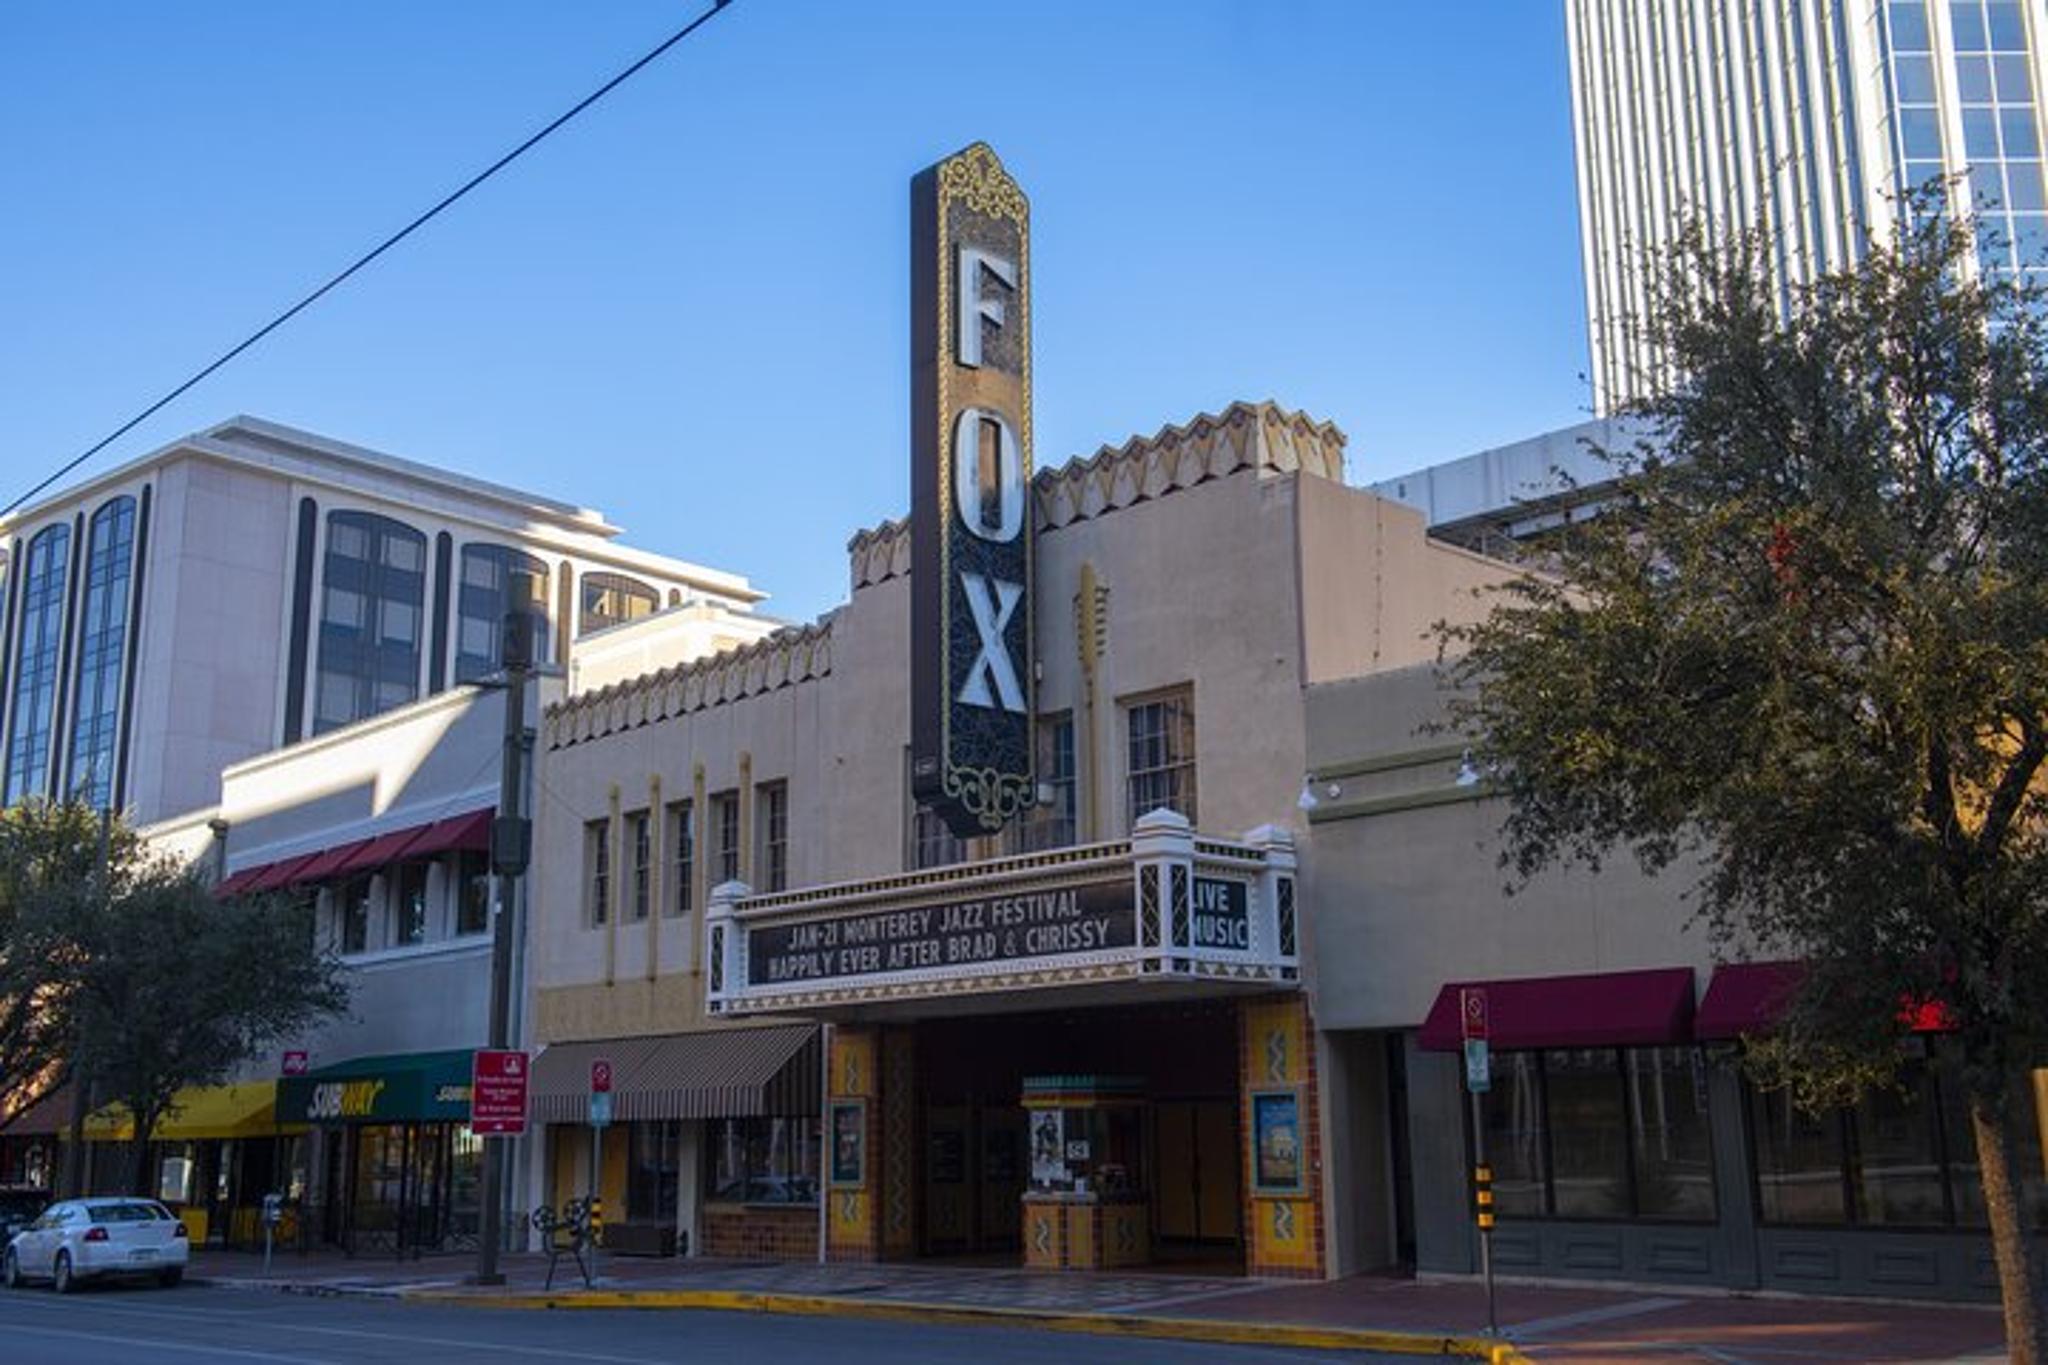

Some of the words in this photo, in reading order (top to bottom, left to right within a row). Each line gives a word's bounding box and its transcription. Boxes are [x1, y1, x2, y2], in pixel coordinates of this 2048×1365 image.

[955, 246, 1027, 715] FOX
[844, 909, 932, 944] MONTEREY
[939, 903, 985, 932] JAZZ
[992, 890, 1082, 926] FESTIVAL
[1194, 881, 1230, 912] IVE
[768, 951, 834, 979] HAPPILY
[841, 946, 881, 973] EVER
[888, 940, 940, 968] AFTER
[948, 932, 997, 962] BRAD
[1003, 929, 1017, 956] &
[1026, 918, 1110, 953] CHRISSY
[307, 1078, 385, 1118] SUBWAY
